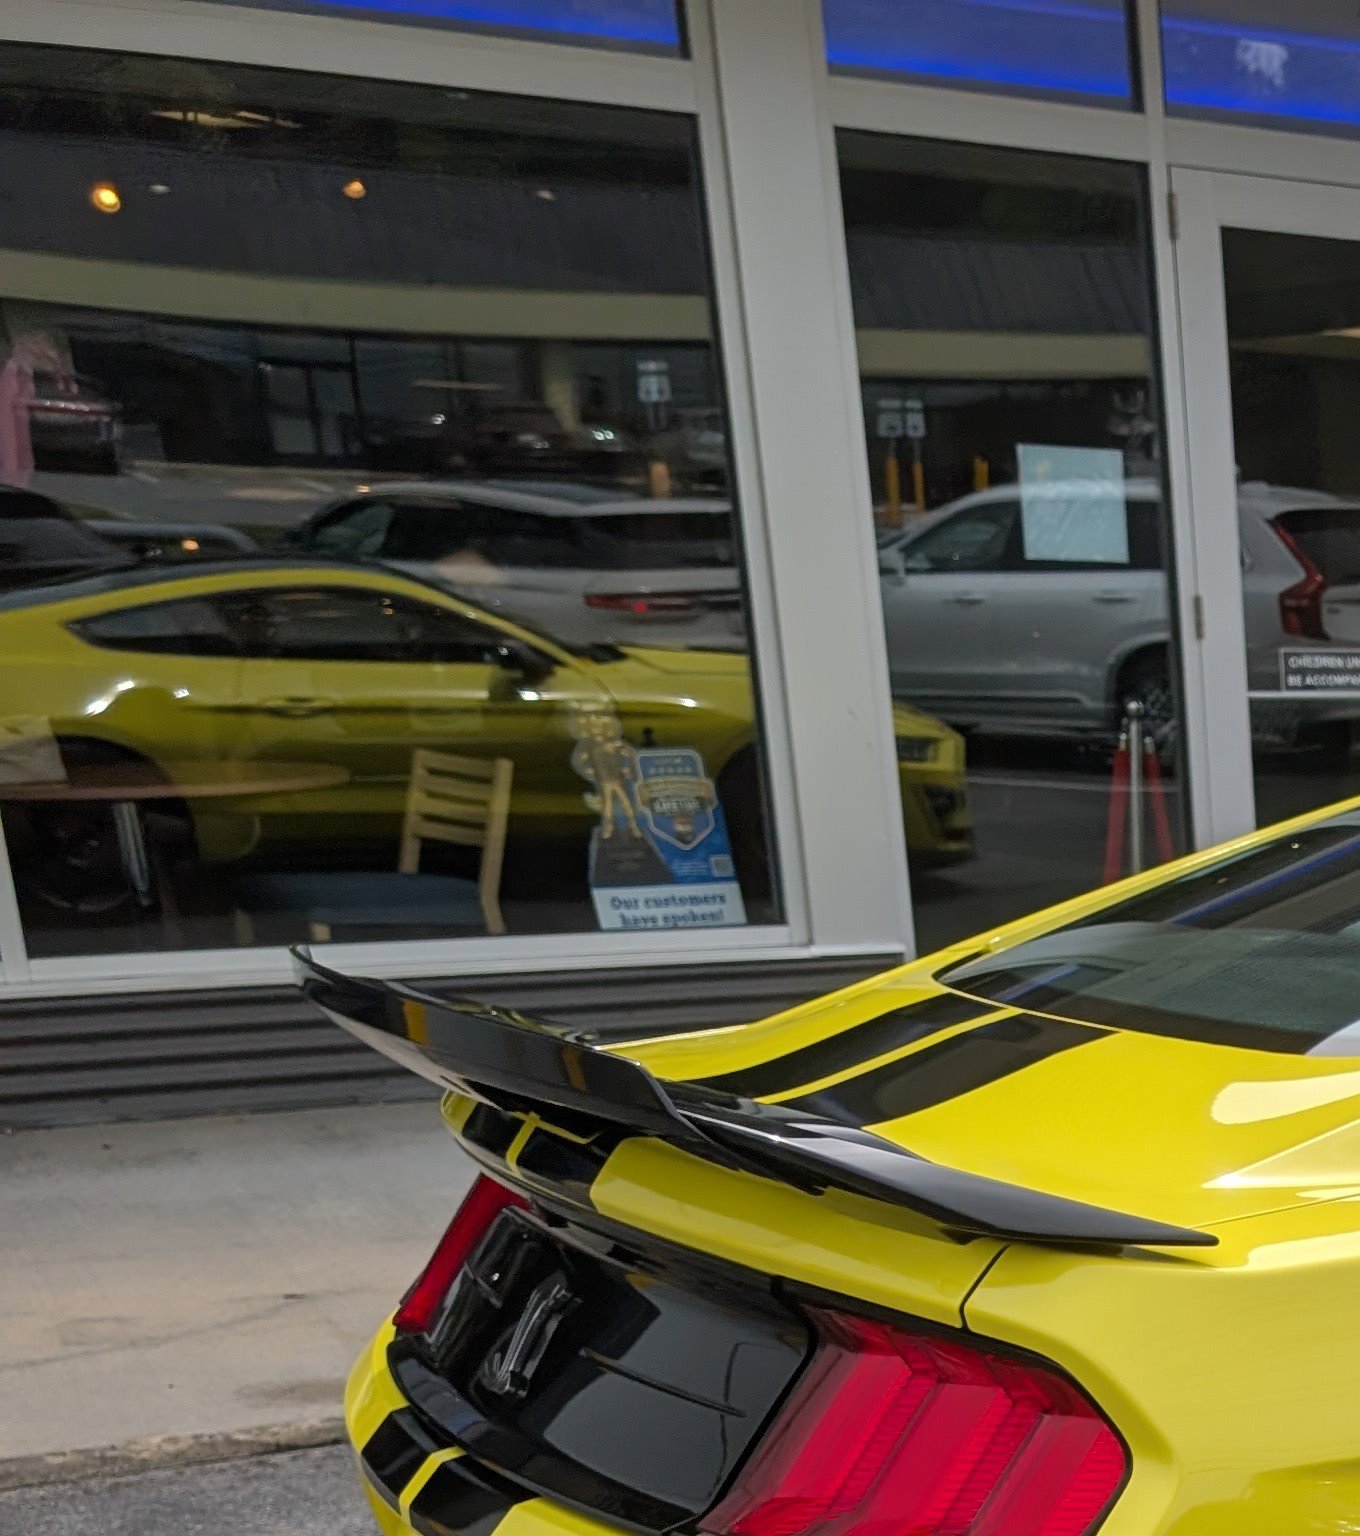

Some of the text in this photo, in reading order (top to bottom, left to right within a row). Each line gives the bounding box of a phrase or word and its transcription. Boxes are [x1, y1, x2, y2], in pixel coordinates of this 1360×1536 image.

[1287, 674, 1302, 687] BE
[610, 893, 727, 912] Our customers
[620, 912, 658, 927] have
